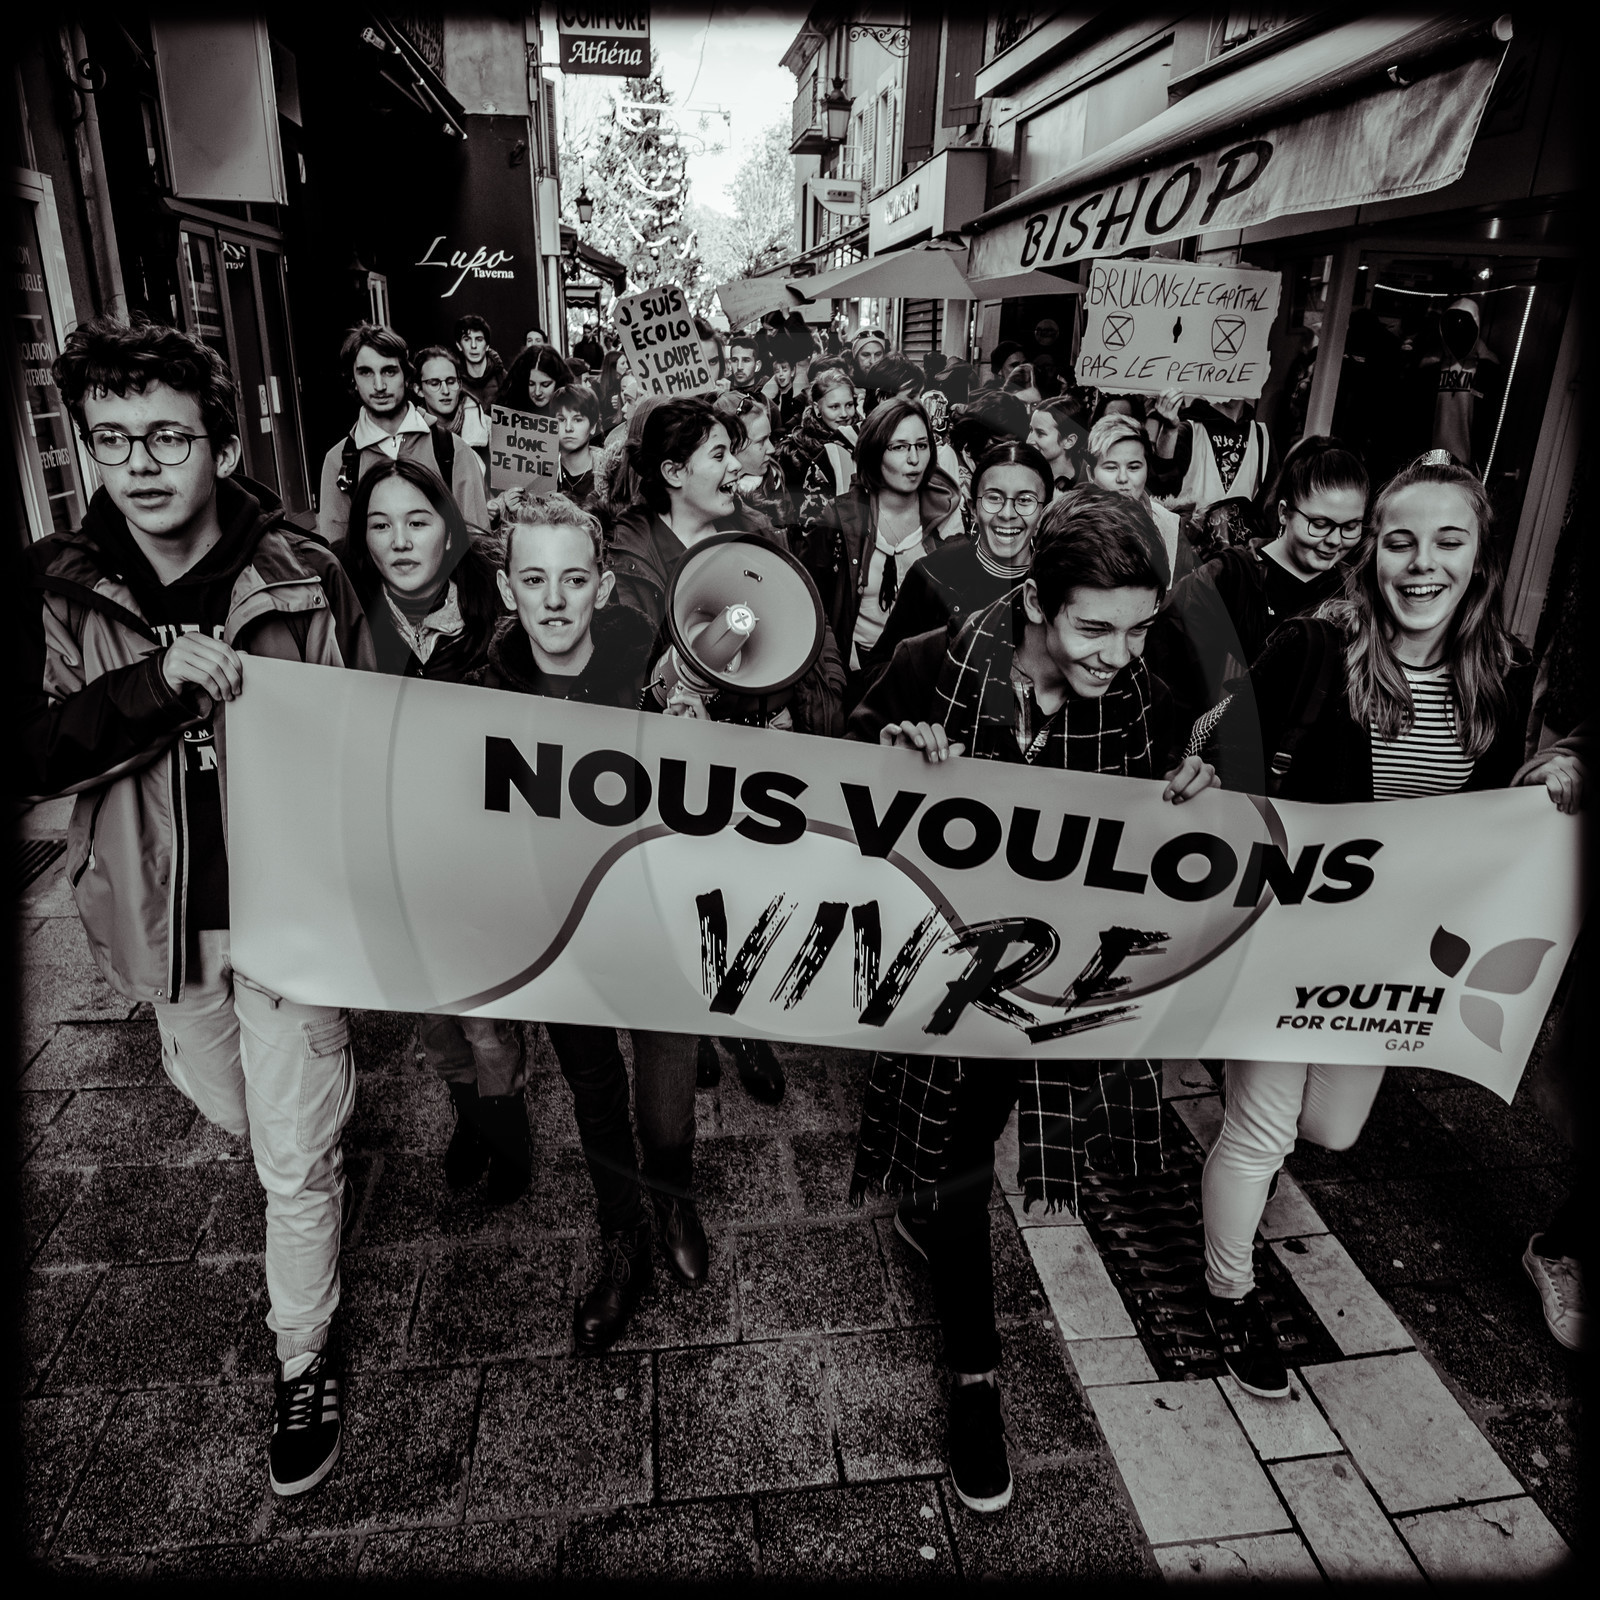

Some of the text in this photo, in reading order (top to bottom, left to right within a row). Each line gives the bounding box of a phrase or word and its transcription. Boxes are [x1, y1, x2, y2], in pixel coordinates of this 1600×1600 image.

[568, 40, 643, 66] Athéna
[1020, 140, 1273, 268] BISHOP
[415, 235, 514, 298] Lupo
[471, 267, 515, 279] Taverna
[1090, 267, 1184, 309] BRULONS
[1180, 277, 1212, 307] LE
[631, 320, 690, 350] ÉCOLO
[1081, 354, 1260, 384] PAS LE PETROLE
[492, 408, 559, 435] JE PENSE
[492, 451, 511, 470] JE
[485, 736, 1384, 907] NOUS VOULONS
[695, 889, 1172, 1044] VIVRE
[1296, 984, 1445, 1014] YOUTH
[1276, 1015, 1433, 1036] FOR CLIMATE
[1385, 1039, 1424, 1052] GAP
